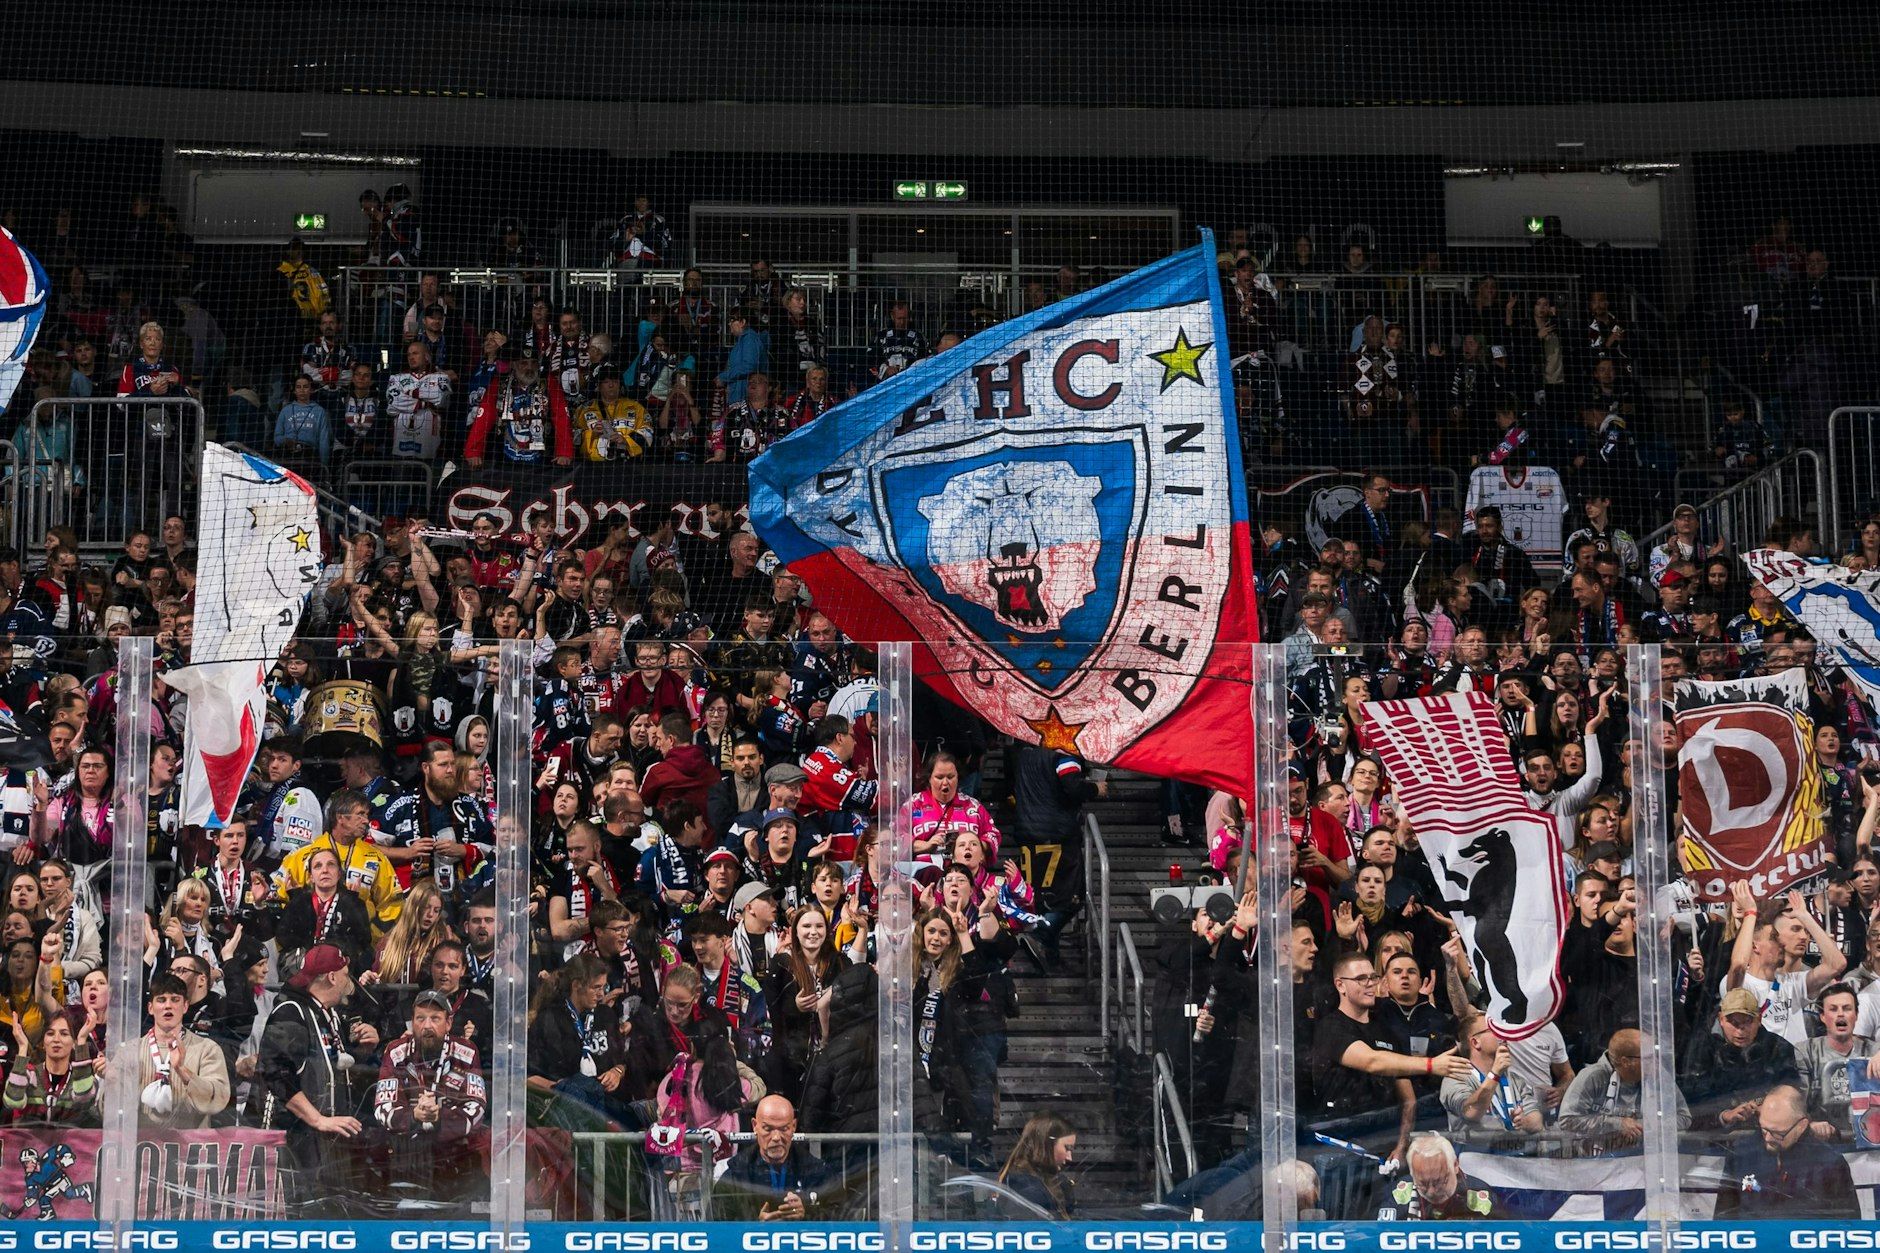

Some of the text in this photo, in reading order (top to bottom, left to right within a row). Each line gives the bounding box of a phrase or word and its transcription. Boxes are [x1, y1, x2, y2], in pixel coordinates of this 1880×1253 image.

[1112, 422, 1205, 712] BERLIN
[287, 826, 313, 839] MOLY
[913, 820, 979, 838] GASAG
[34, 1230, 179, 1251] GASAG
[212, 1230, 357, 1251] GASAG
[390, 1230, 531, 1251] GASAG
[564, 1230, 709, 1251] GASAG
[742, 1230, 885, 1251] GASAG
[909, 1230, 1051, 1251] GASAG
[1085, 1230, 1227, 1251] GASAG
[1379, 1230, 1522, 1251] GASAG
[1790, 1230, 1880, 1251] GAS
